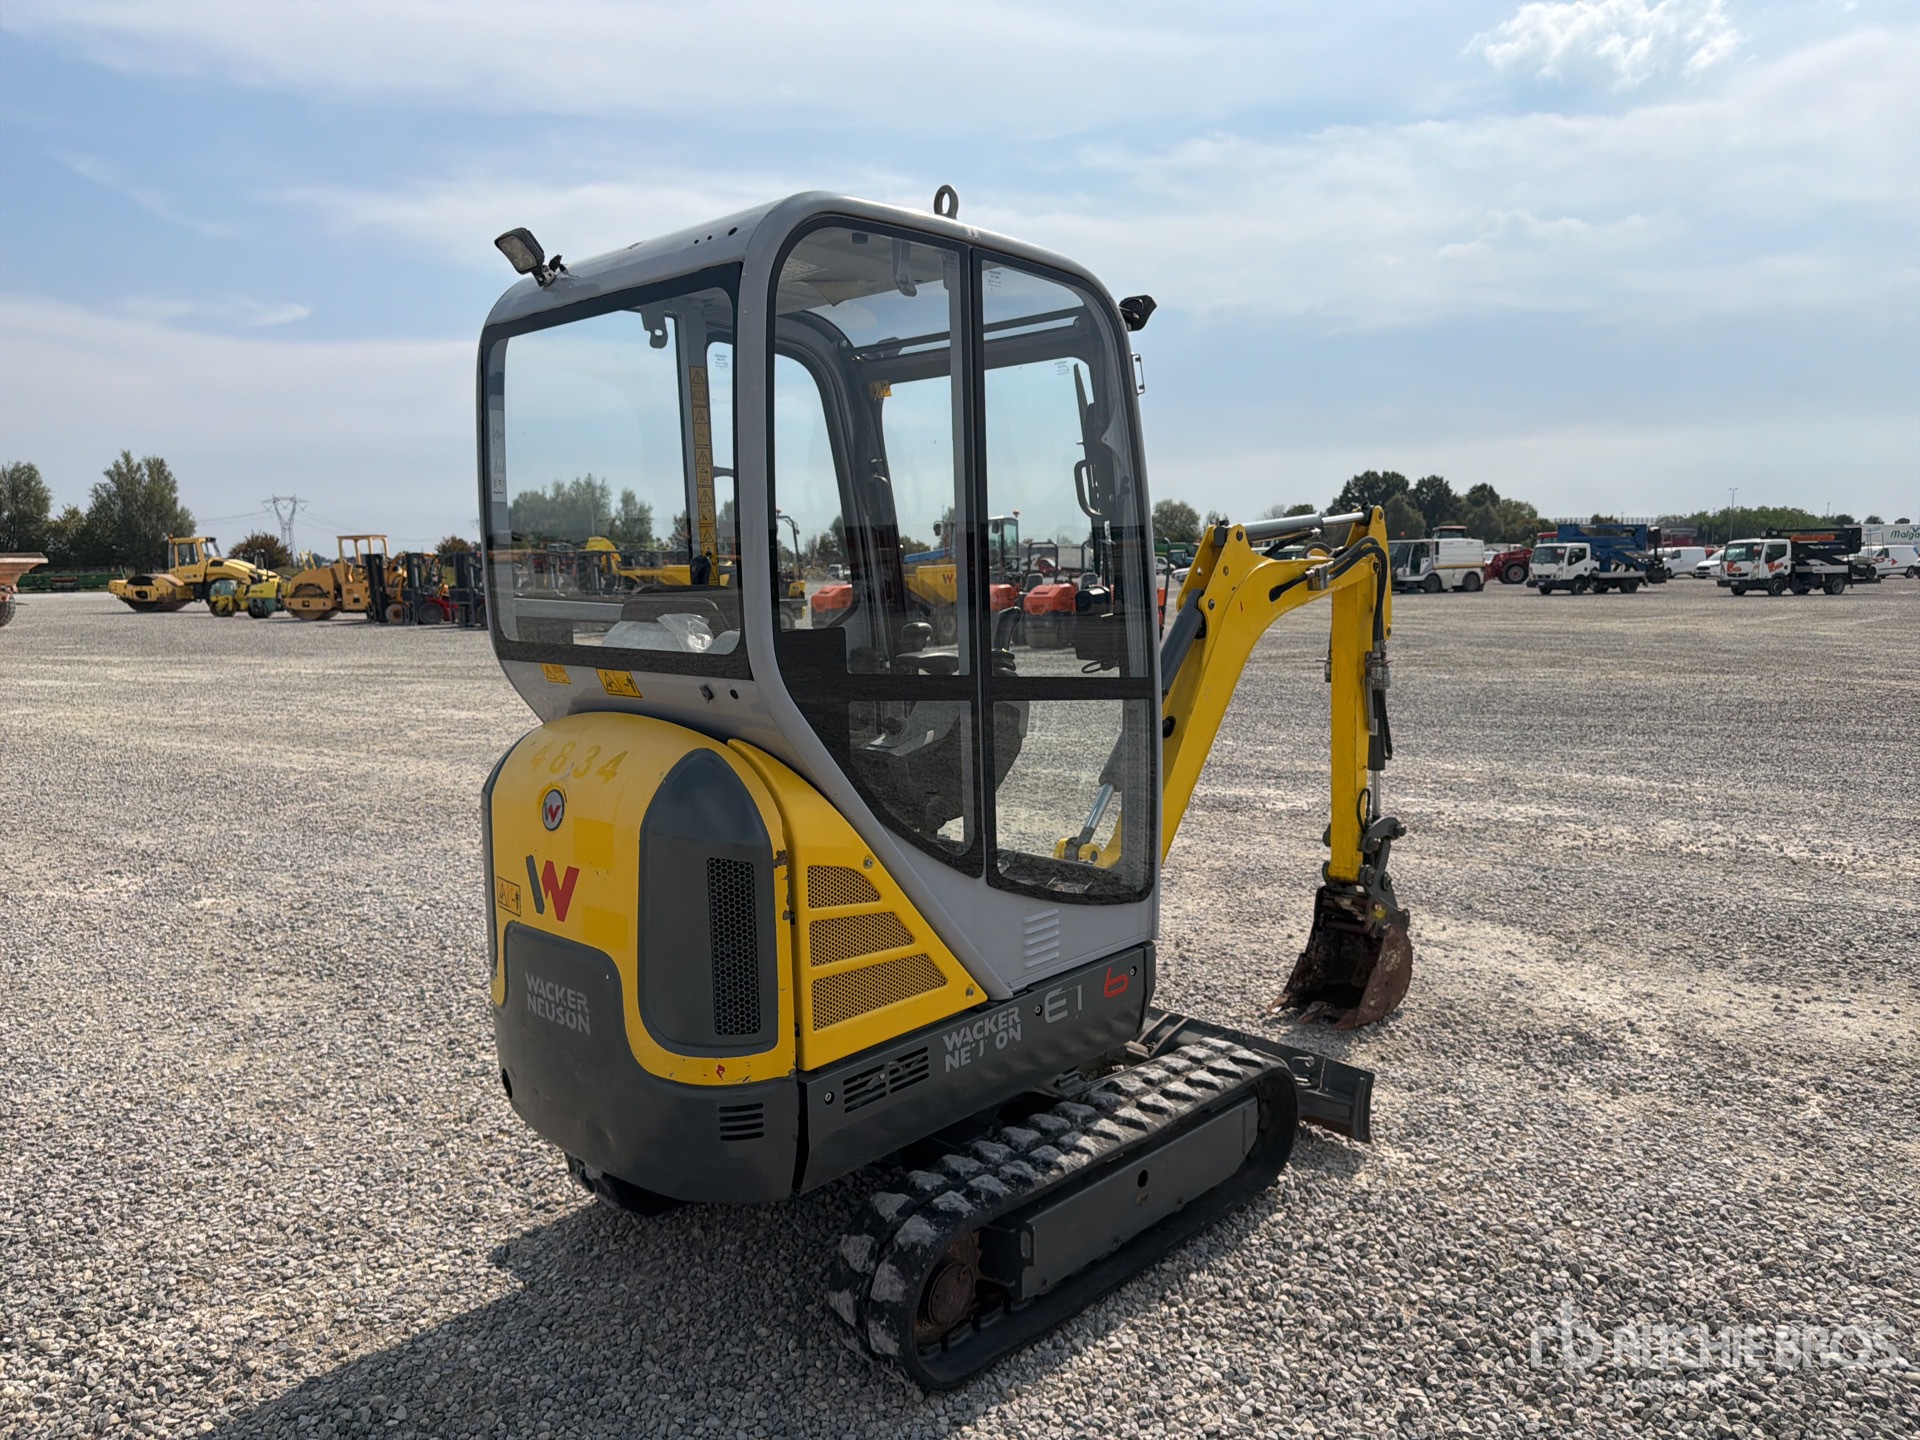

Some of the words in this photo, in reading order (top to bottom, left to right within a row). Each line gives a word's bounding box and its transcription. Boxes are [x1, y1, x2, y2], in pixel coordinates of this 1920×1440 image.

[530, 740, 629, 785] 4834
[524, 972, 590, 1012] WACKER
[526, 994, 592, 1035] NEUSON
[942, 1006, 1022, 1052] WACKER
